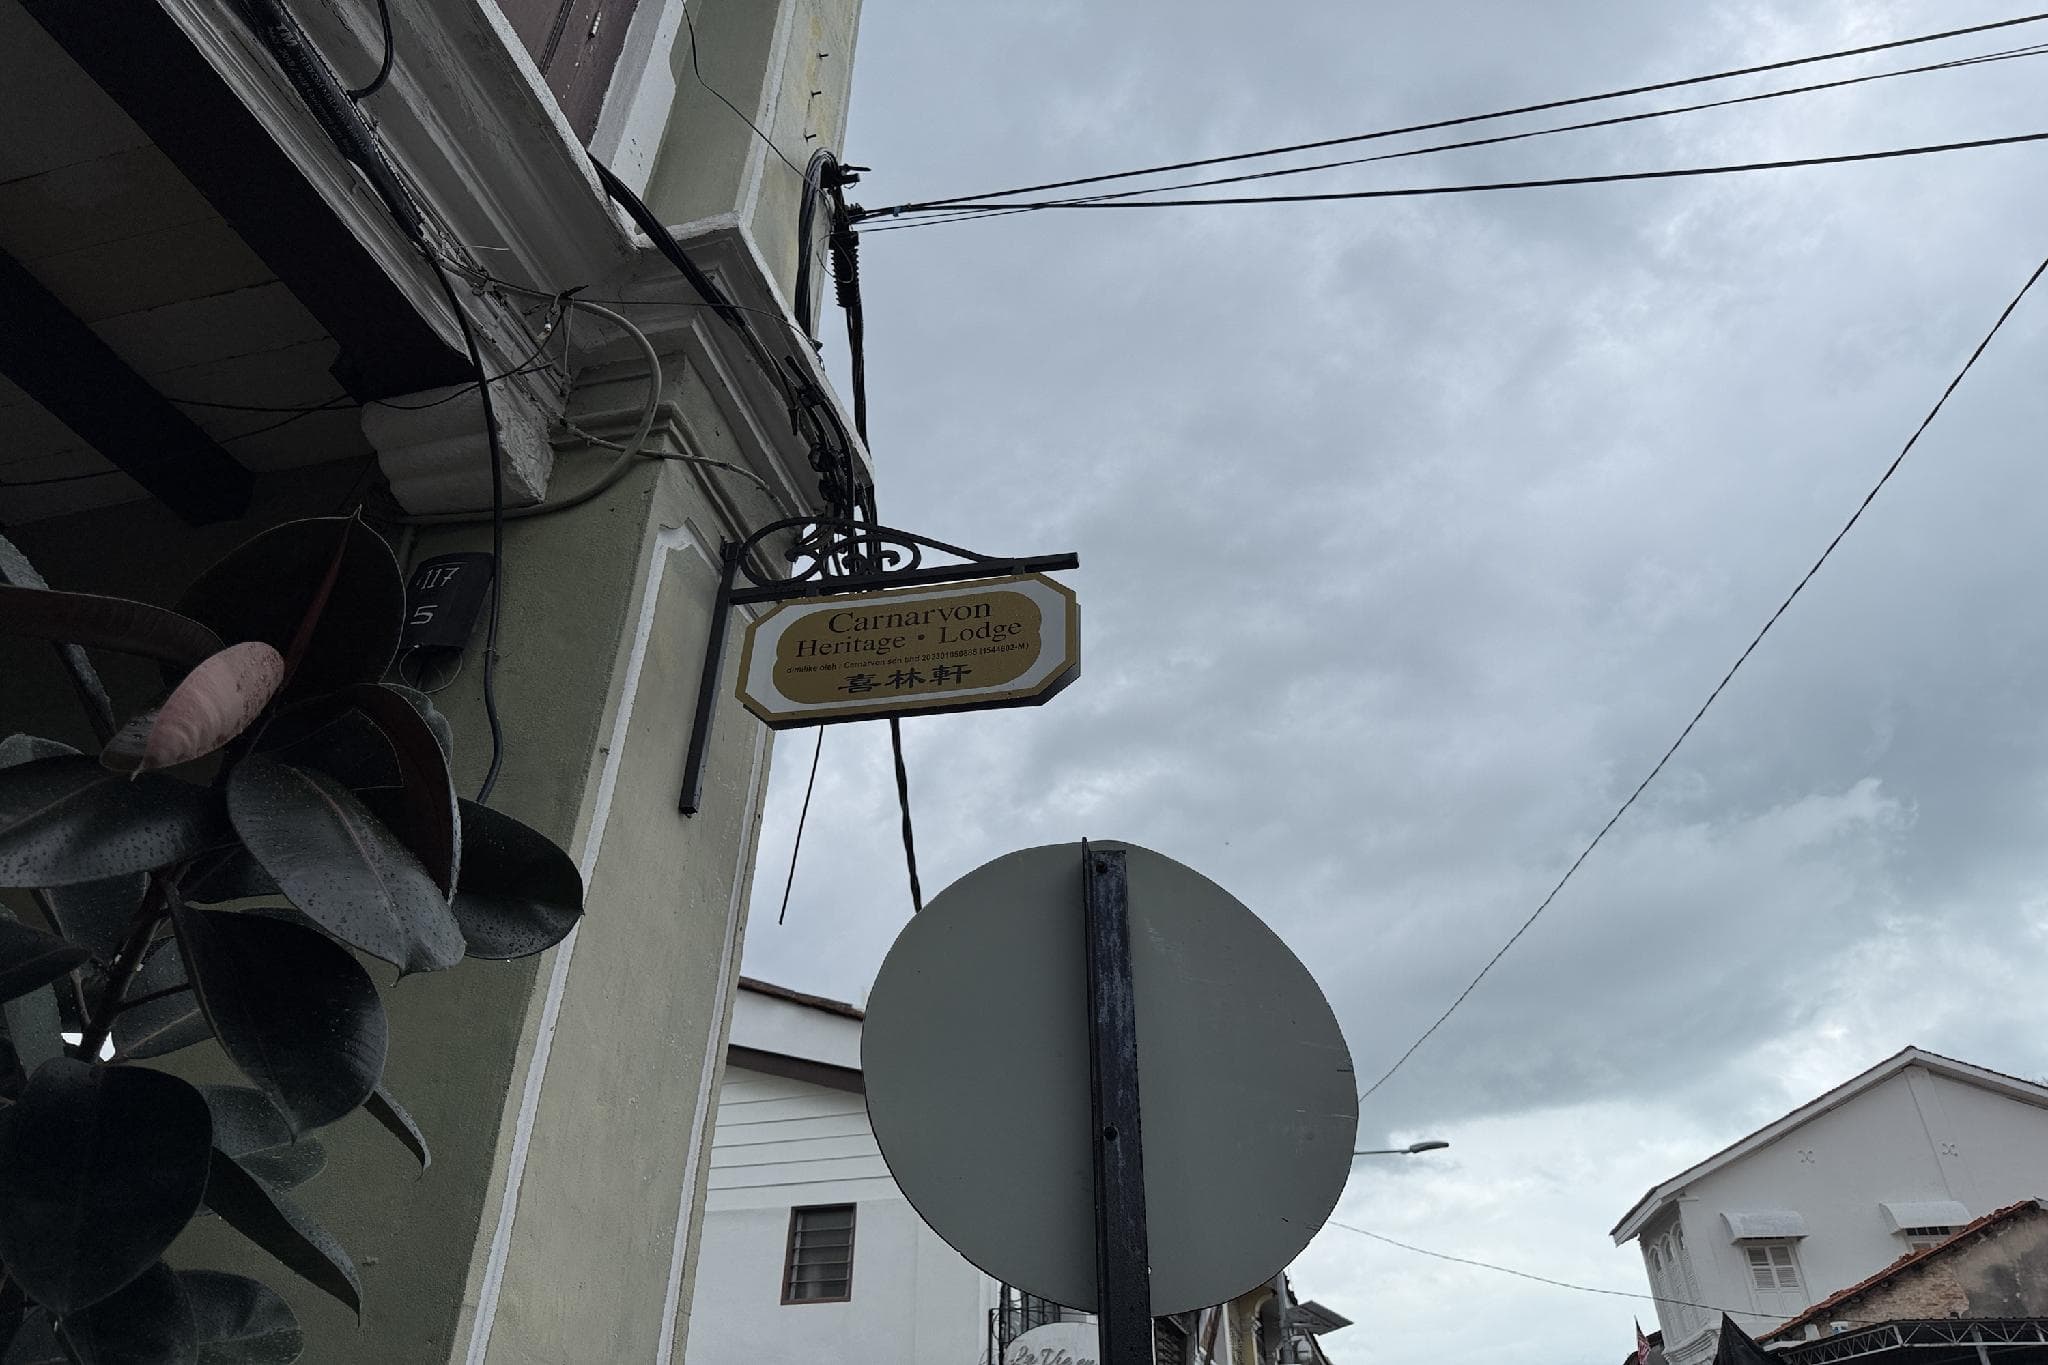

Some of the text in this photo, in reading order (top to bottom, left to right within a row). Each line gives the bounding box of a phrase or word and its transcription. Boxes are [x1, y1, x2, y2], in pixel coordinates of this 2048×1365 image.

[828, 601, 992, 634] Carnarvon
[795, 619, 1022, 657] Heritage Lodge
[838, 664, 972, 694] 喜林軒
